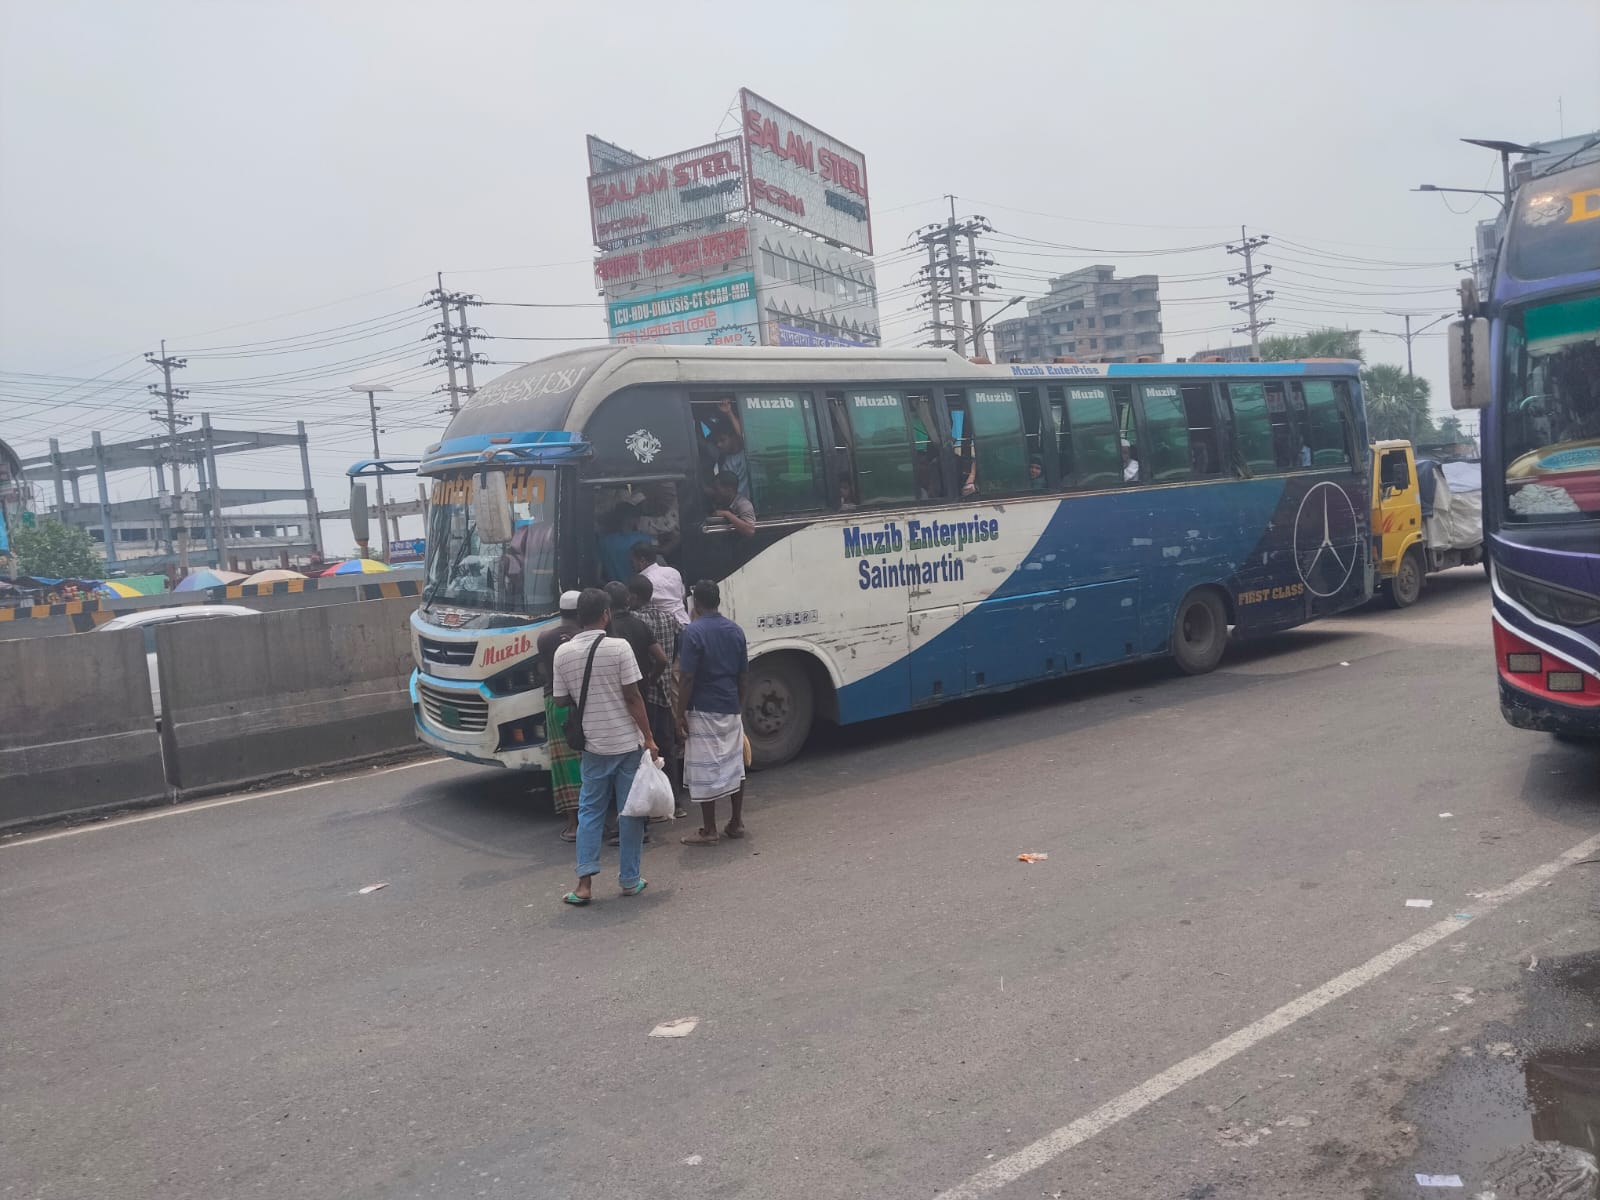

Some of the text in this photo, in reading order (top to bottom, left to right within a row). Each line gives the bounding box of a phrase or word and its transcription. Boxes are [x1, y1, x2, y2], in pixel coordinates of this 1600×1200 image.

[747, 109, 866, 198] SALAM STEEL
[591, 168, 668, 208] SALAM
[672, 151, 741, 188] STEEL
[714, 333, 742, 345] BMD
[1010, 365, 1044, 376] Muzib
[975, 392, 1013, 403] Muzib
[1071, 389, 1104, 400] Muzib
[1146, 387, 1177, 398] Muzib
[746, 397, 795, 410] Muzib
[854, 395, 898, 407] Muzib
[843, 514, 999, 559] Muzib Enterprise
[858, 553, 964, 590] Saintmartin
[1238, 583, 1304, 606] FIRST CLASS
[480, 634, 532, 668] Muzib
